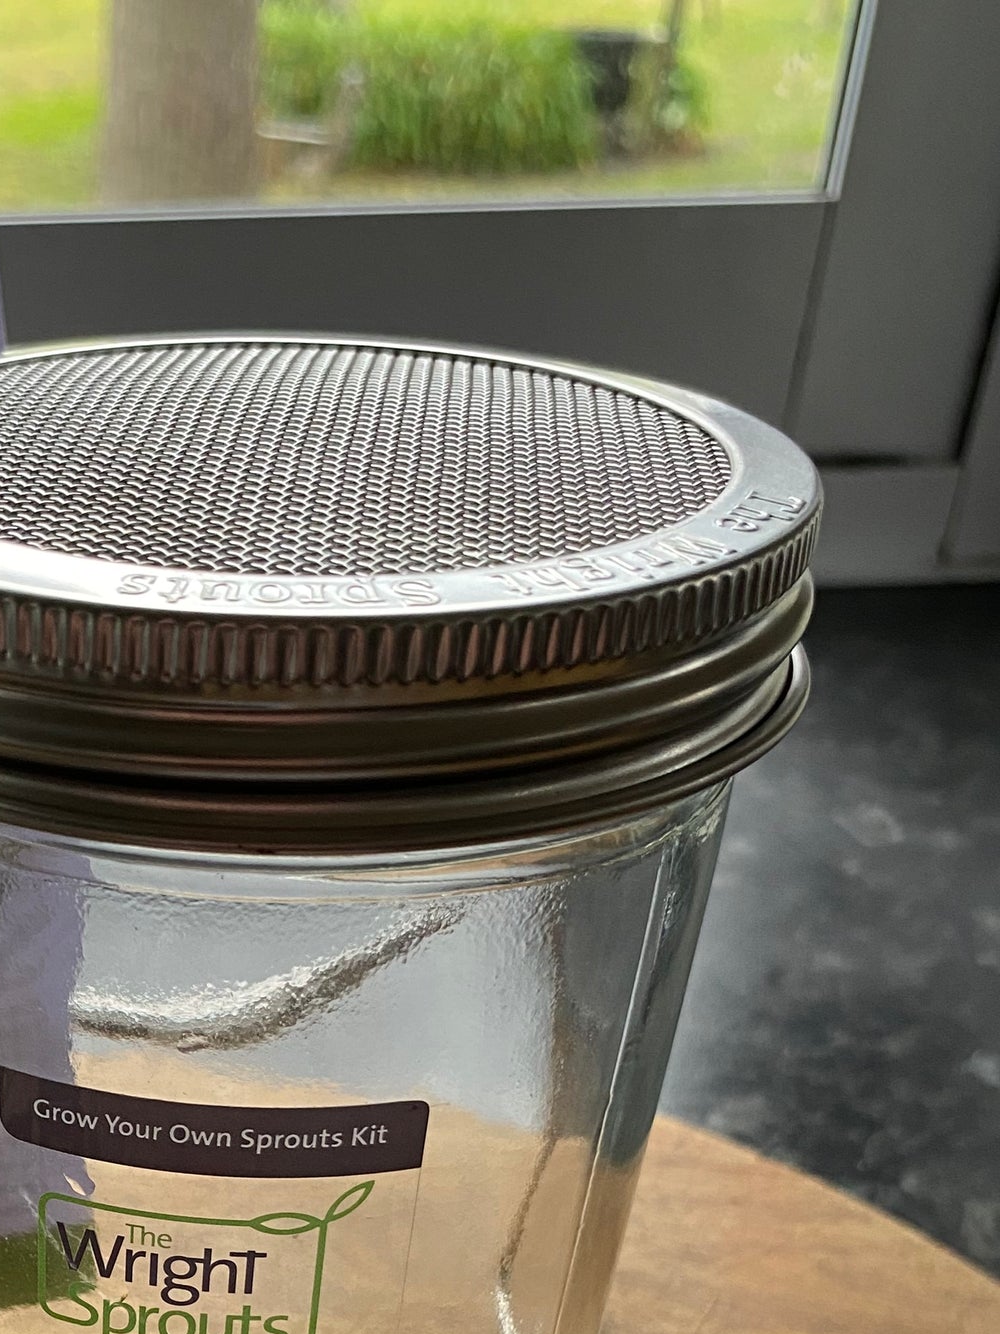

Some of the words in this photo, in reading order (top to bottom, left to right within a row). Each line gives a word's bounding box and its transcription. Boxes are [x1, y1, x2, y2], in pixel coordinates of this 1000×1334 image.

[714, 488, 806, 536] The
[116, 571, 446, 610] Sprouts
[492, 536, 739, 599] Wright
[32, 1098, 99, 1130] Grow
[104, 1112, 163, 1142] Your
[168, 1123, 232, 1148] Own
[240, 1127, 344, 1155] Sprouts
[350, 1123, 389, 1148] Kit
[125, 1223, 173, 1249] The
